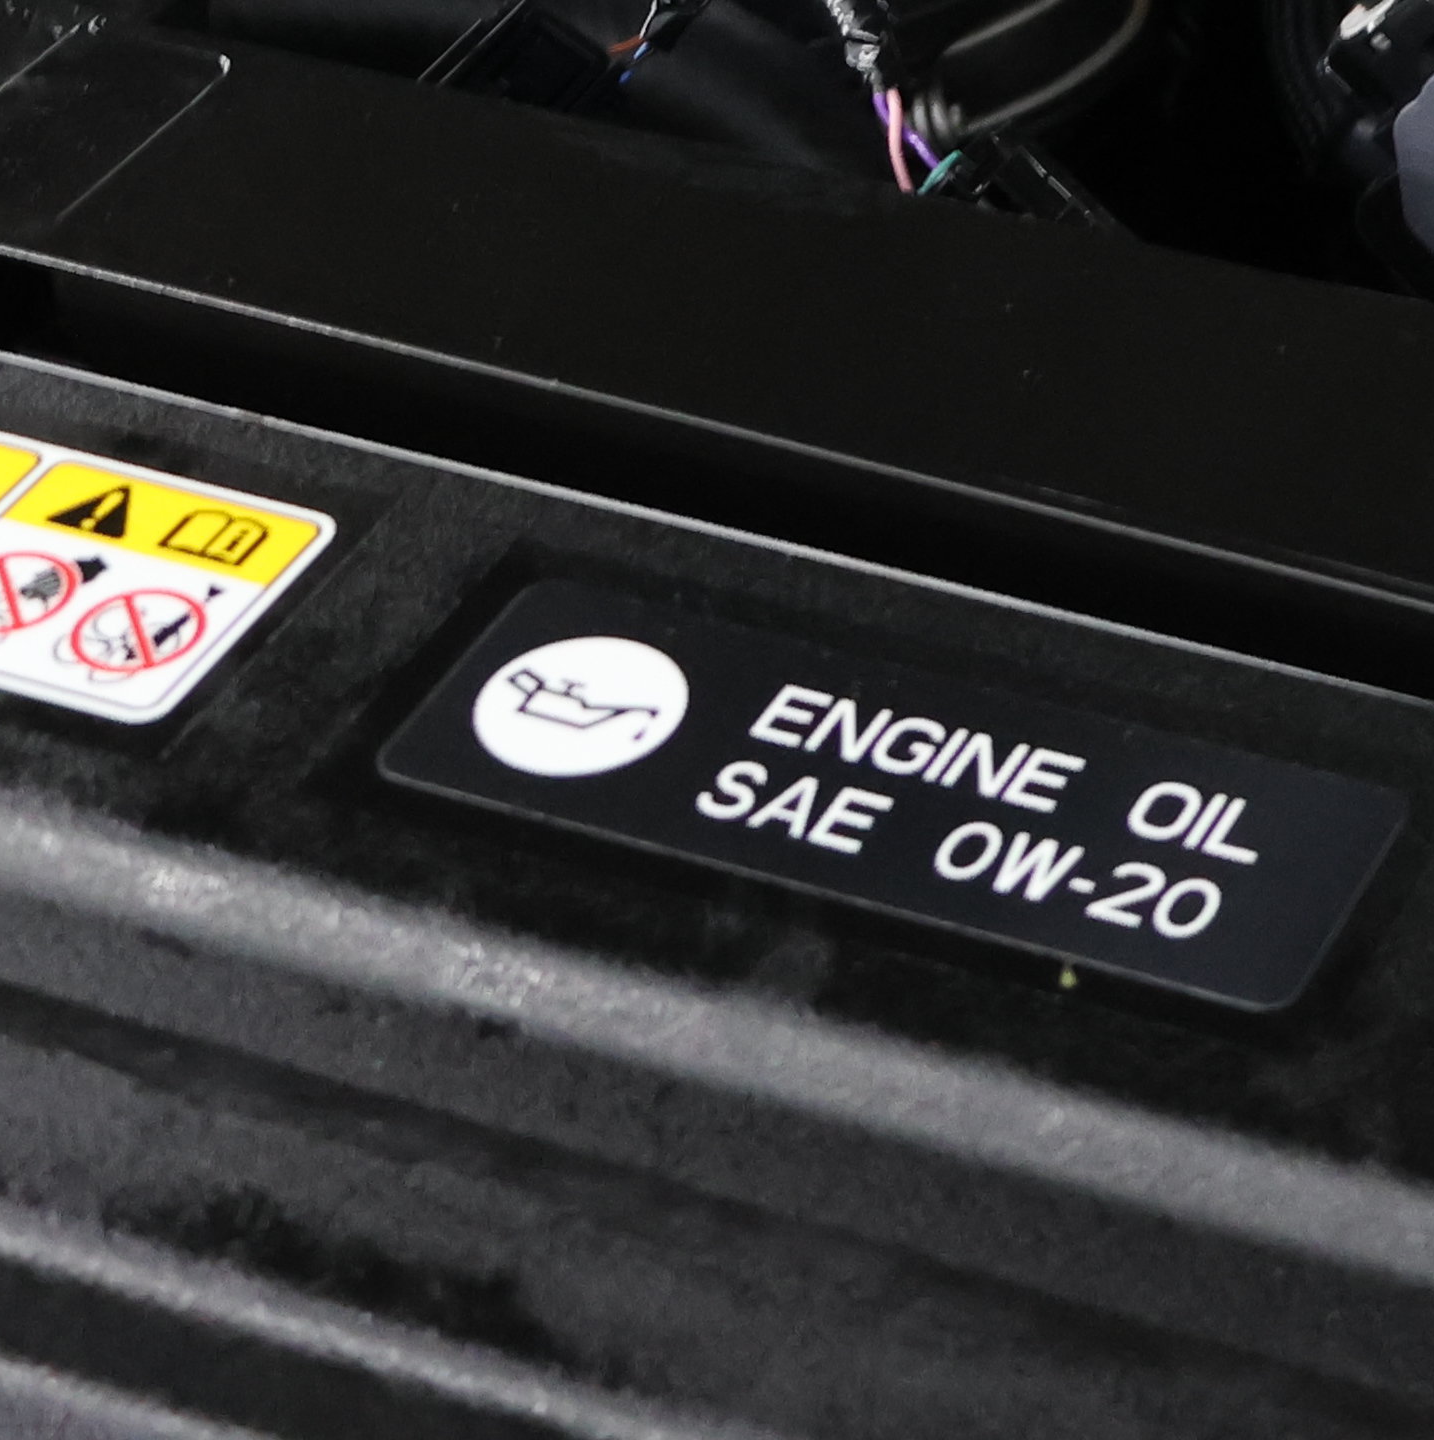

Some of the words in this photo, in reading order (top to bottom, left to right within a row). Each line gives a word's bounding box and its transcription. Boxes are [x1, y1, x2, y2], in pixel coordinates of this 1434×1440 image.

[696, 761, 892, 855] SAE
[935, 821, 1223, 940] 0W-20
[748, 684, 1085, 814] ENGINE
[1128, 781, 1259, 865] OIL
